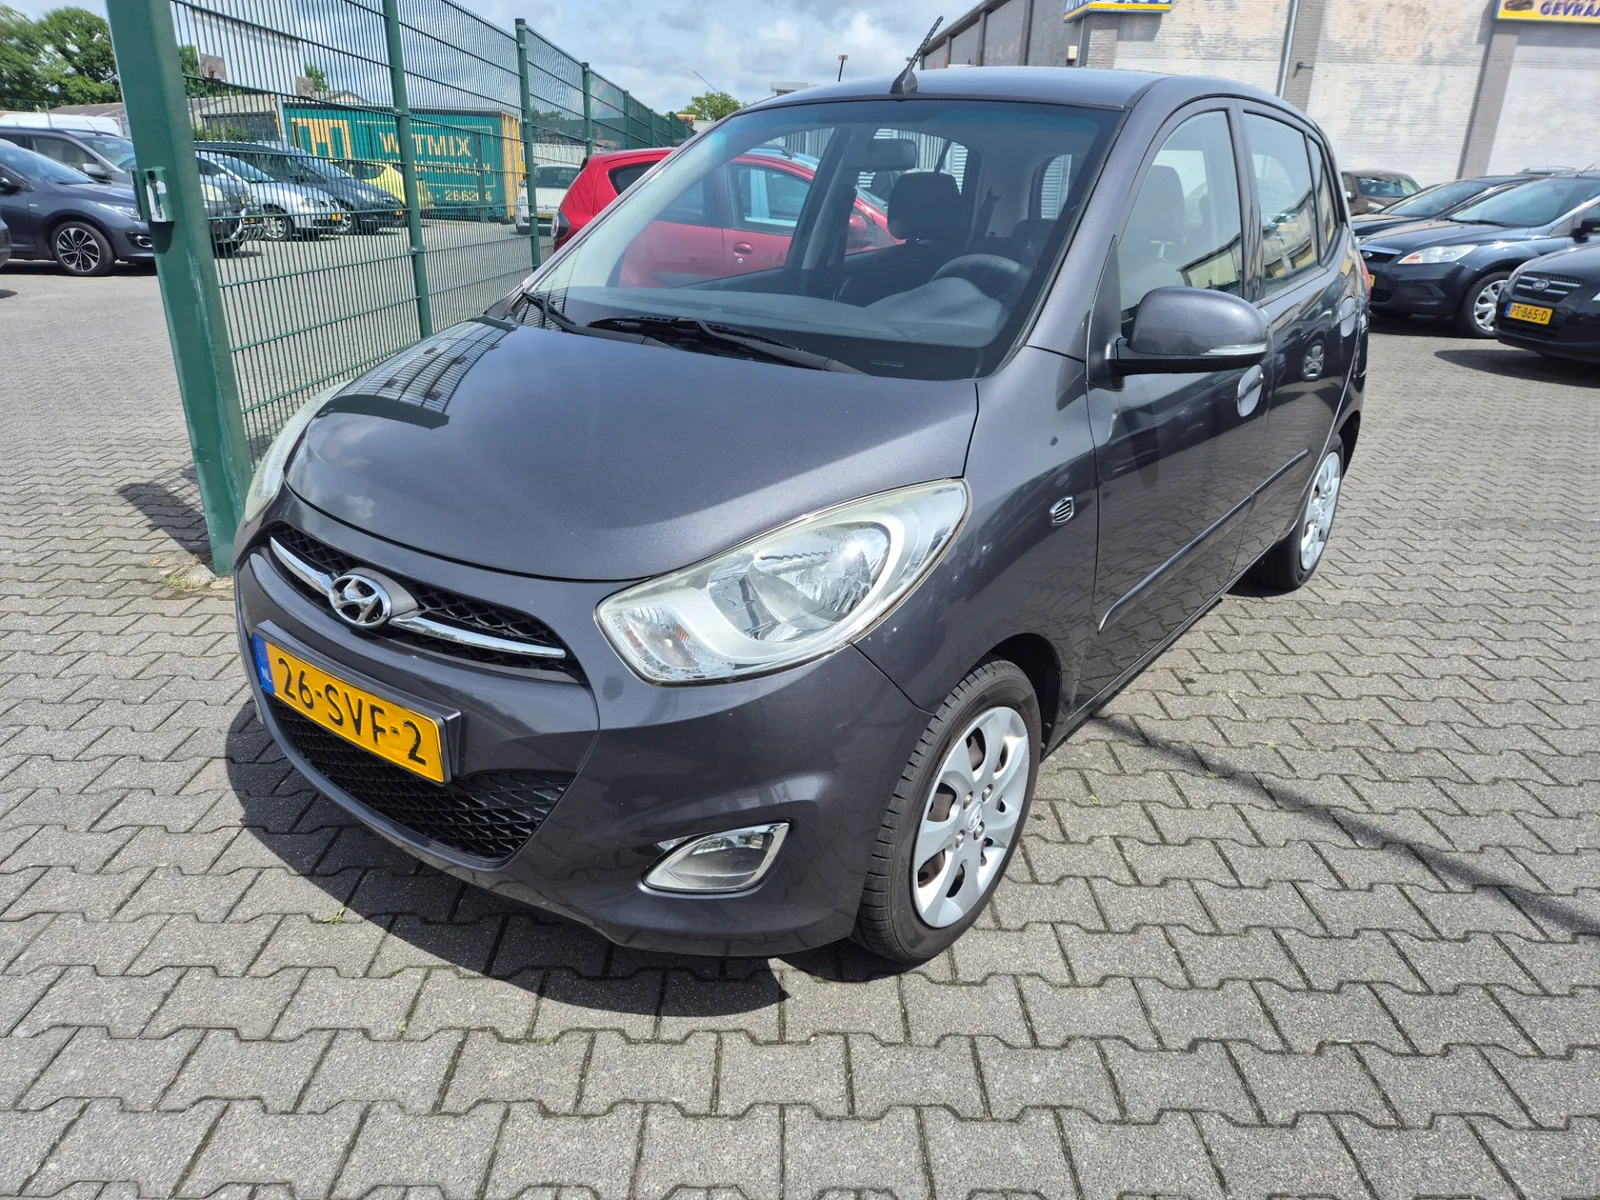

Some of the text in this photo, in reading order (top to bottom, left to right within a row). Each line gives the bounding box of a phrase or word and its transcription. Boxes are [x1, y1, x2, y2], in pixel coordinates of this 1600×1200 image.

[379, 132, 472, 157] WTMIX
[1511, 304, 1548, 322] PT-865-D
[277, 657, 427, 766] 26-SVF-2
